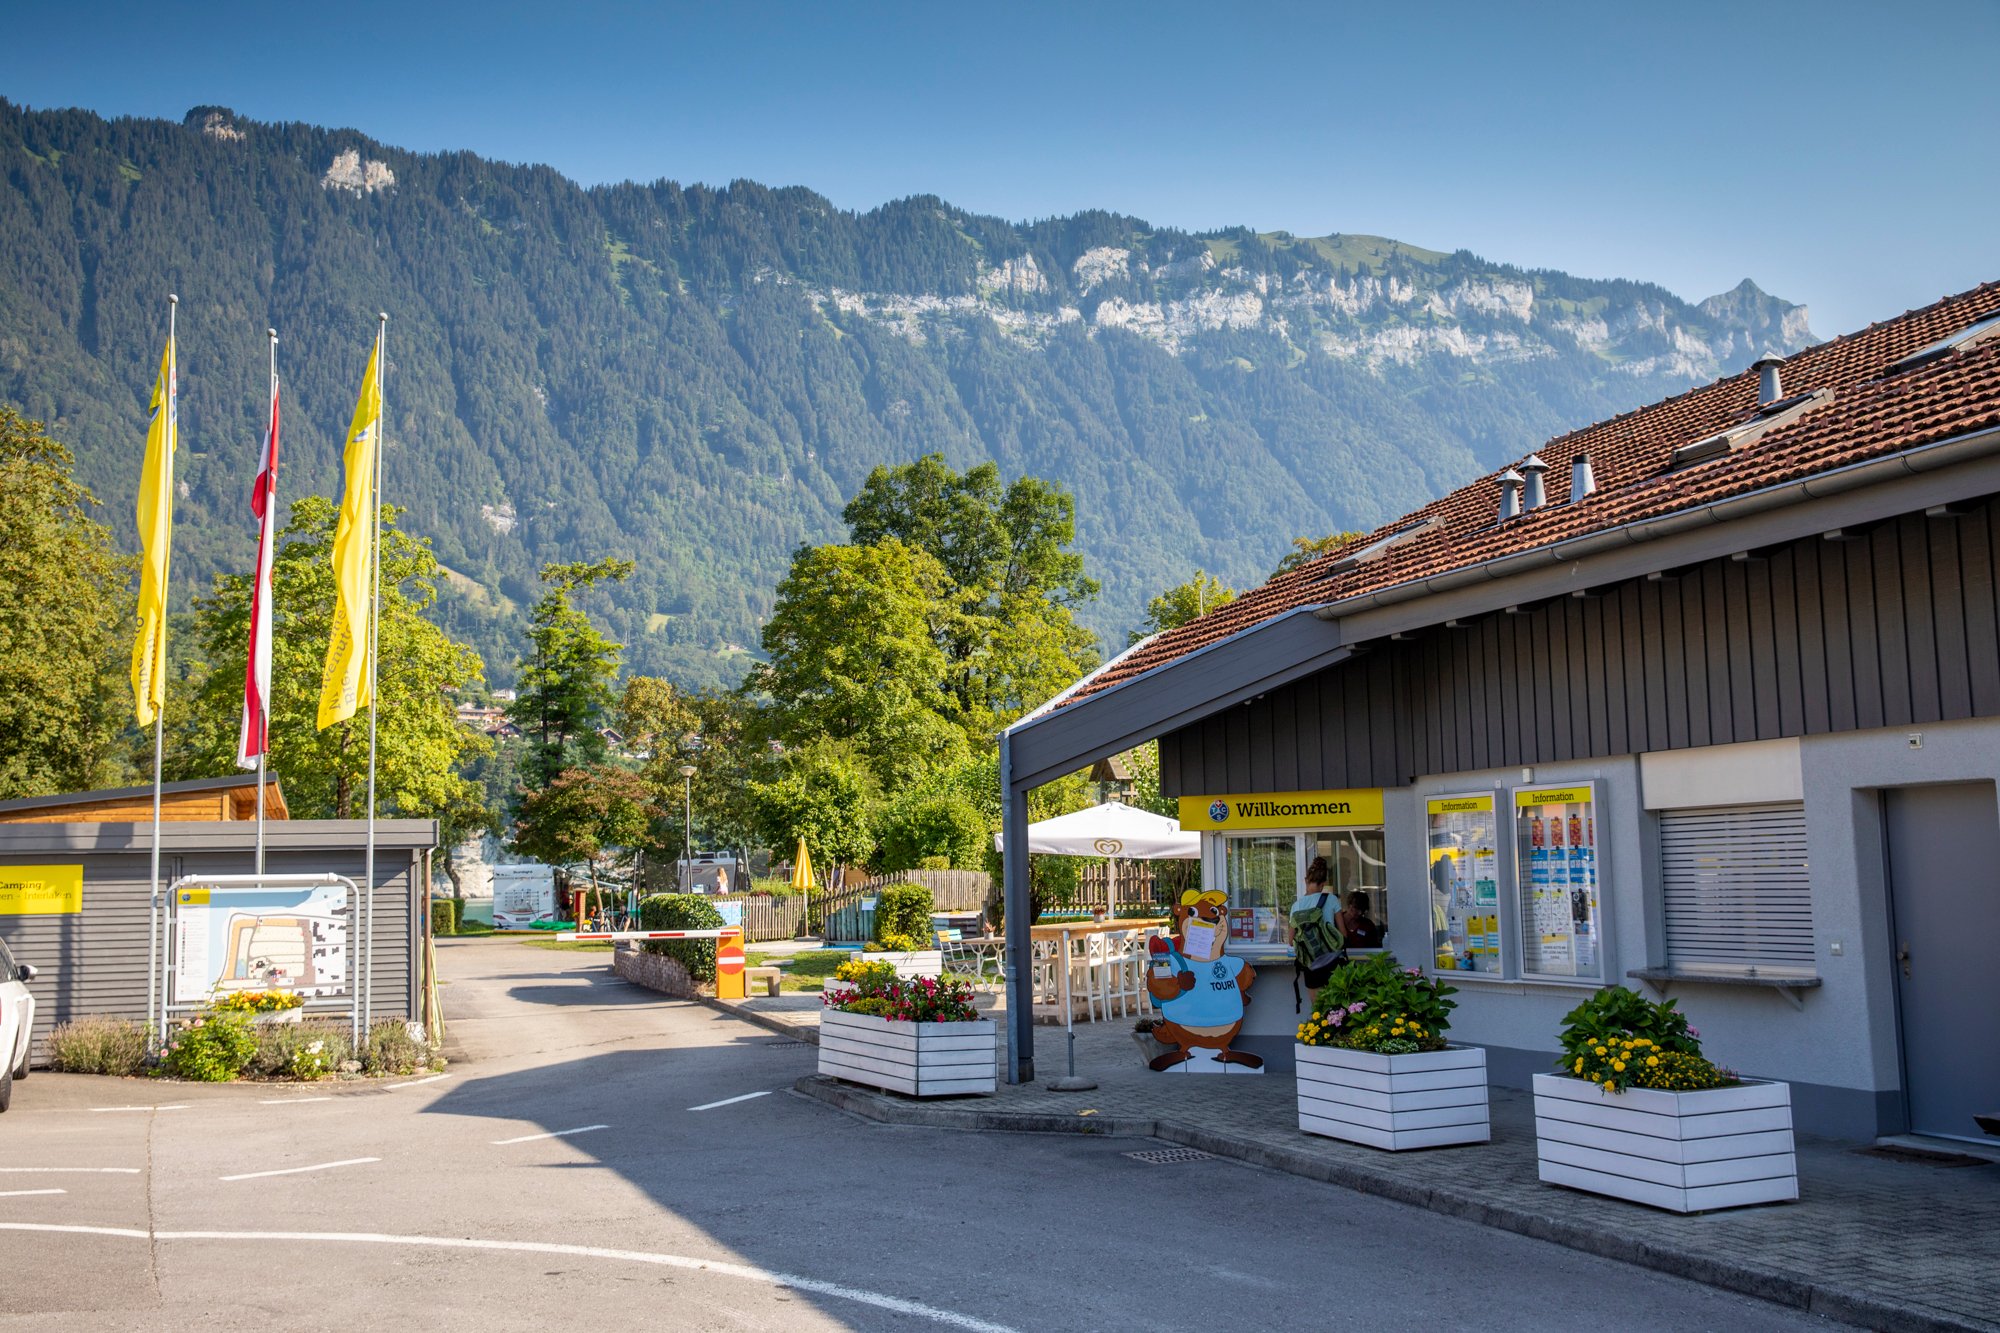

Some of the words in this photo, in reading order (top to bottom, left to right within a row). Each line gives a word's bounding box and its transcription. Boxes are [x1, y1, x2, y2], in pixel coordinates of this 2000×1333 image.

[1532, 792, 1575, 803] Information
[1236, 802, 1352, 817] Willkommen
[1441, 801, 1478, 811] Information
[1210, 980, 1236, 991] TOURI
